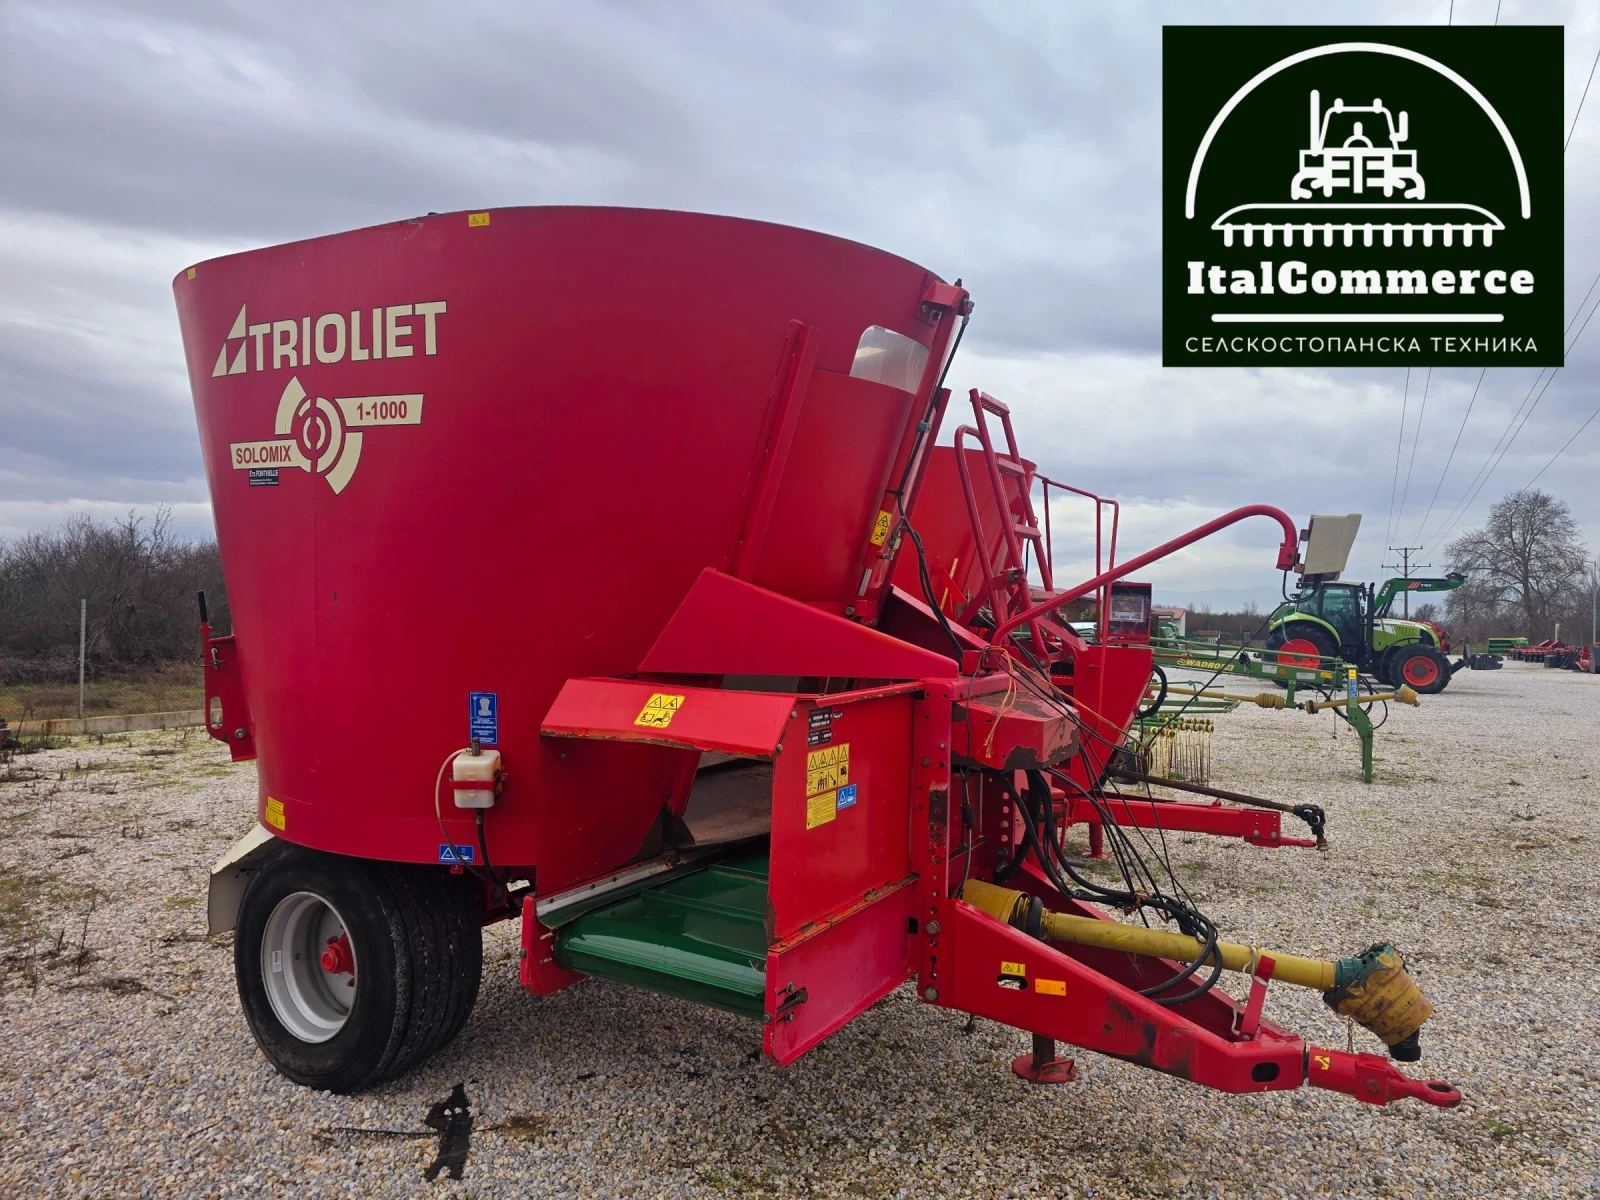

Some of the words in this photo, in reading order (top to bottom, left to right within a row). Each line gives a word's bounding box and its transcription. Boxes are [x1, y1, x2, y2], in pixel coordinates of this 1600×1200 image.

[248, 300, 448, 373] TRIOLIET
[356, 400, 408, 421] 1-1000
[235, 444, 293, 465] SOLOMIX
